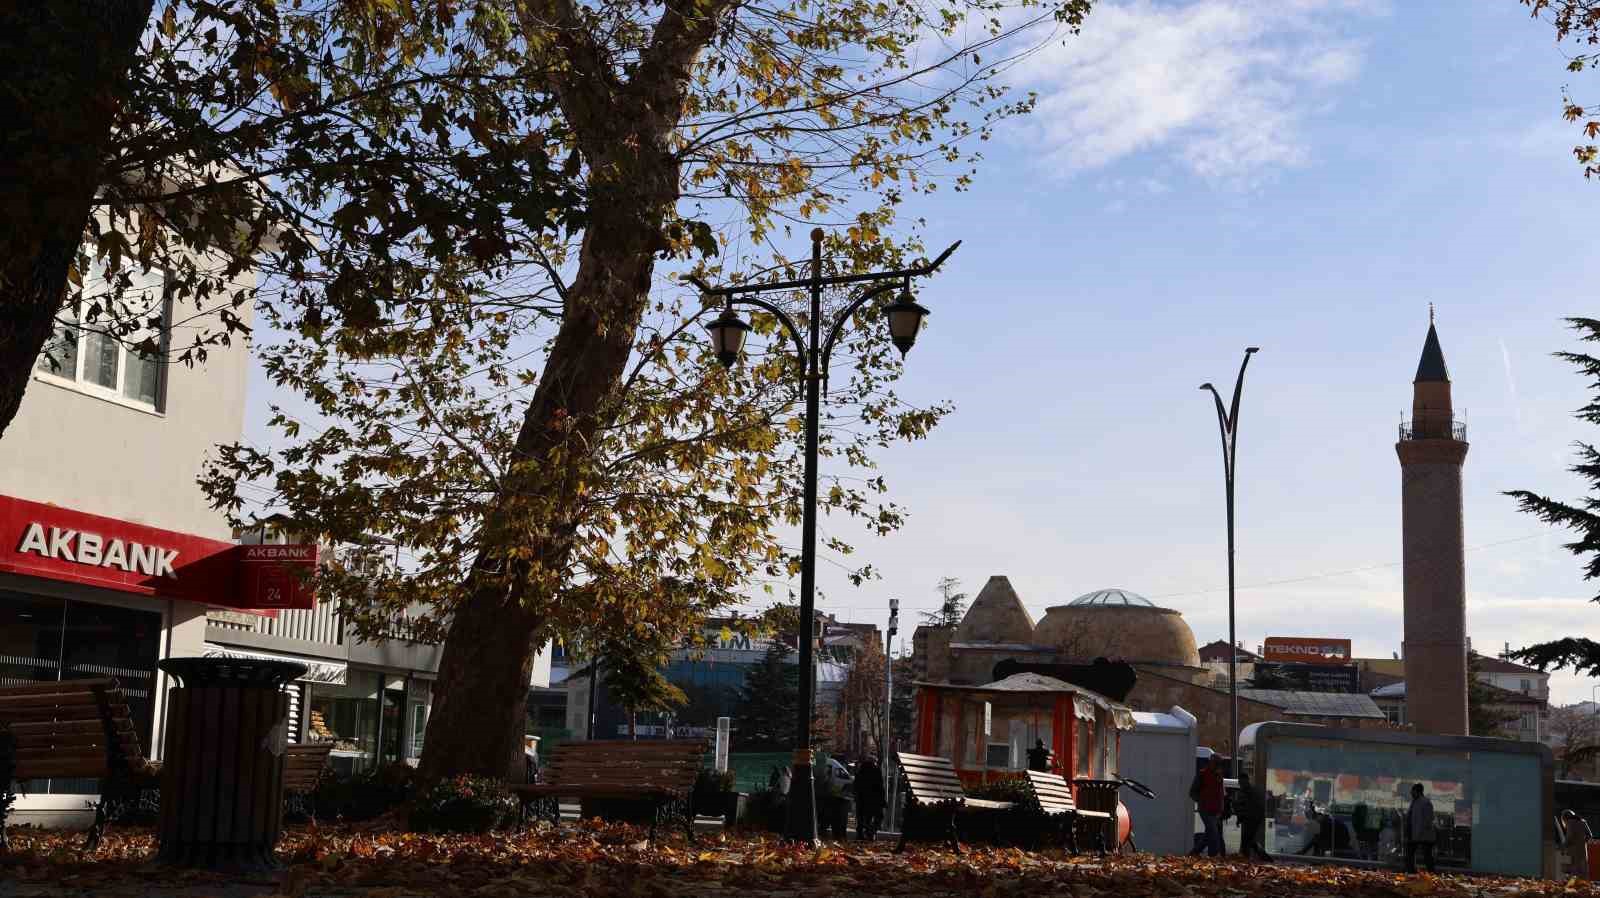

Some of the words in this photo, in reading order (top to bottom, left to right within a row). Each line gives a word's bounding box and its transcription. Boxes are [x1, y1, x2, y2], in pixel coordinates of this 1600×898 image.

[18, 522, 179, 580] AKBANK
[247, 548, 309, 558] AKBANK
[267, 587, 281, 601] 24
